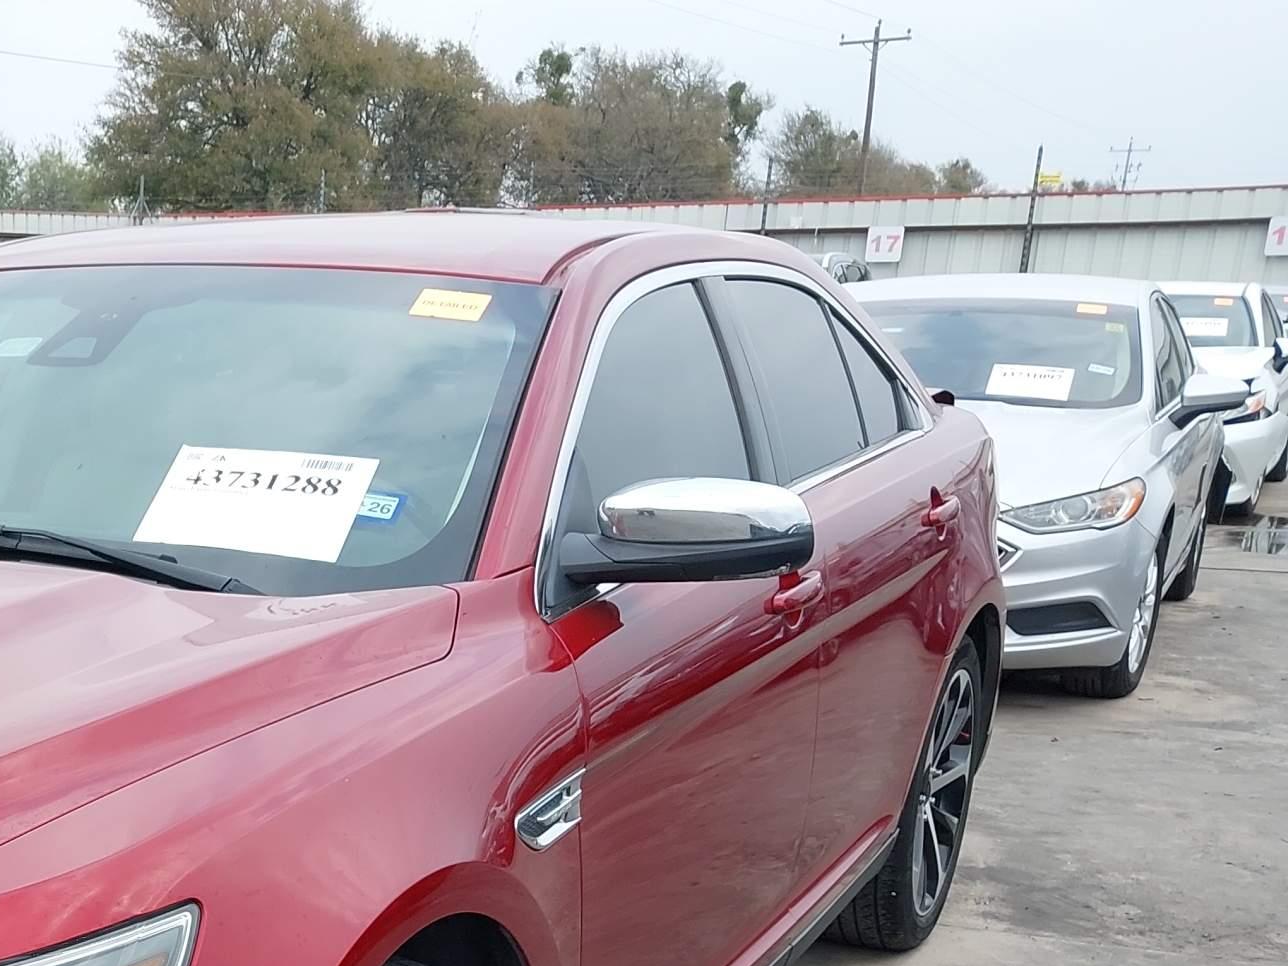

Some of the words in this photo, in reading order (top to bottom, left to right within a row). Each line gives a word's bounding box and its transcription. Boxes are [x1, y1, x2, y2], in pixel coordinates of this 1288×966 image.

[871, 235, 900, 252] 17
[185, 468, 342, 496] 43731288
[367, 501, 393, 515] 26
